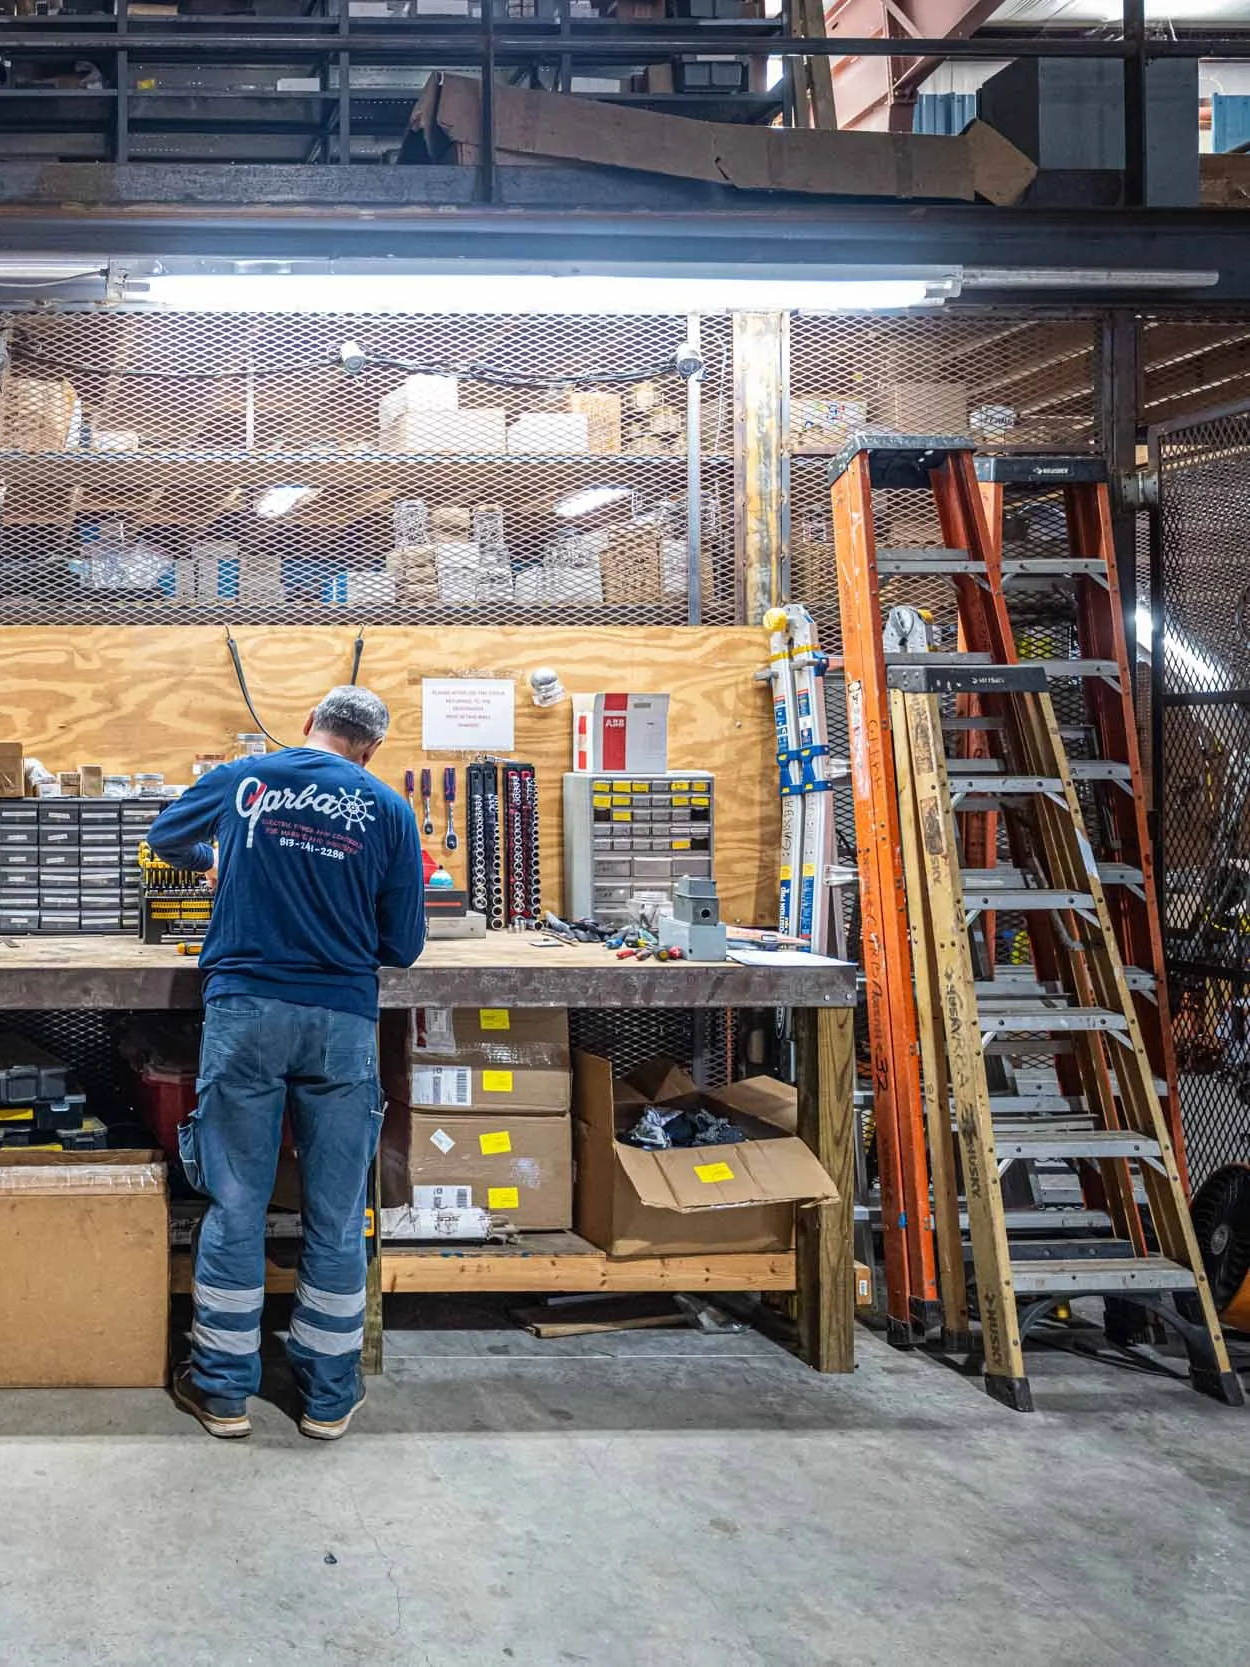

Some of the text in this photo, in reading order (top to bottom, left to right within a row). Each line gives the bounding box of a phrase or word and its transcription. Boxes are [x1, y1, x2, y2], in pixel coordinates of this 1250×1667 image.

[605, 719, 625, 728] ABB
[279, 836, 345, 860] 813-241-2288
[778, 903, 786, 933] OSITION
[966, 1143, 981, 1200] HUSKY
